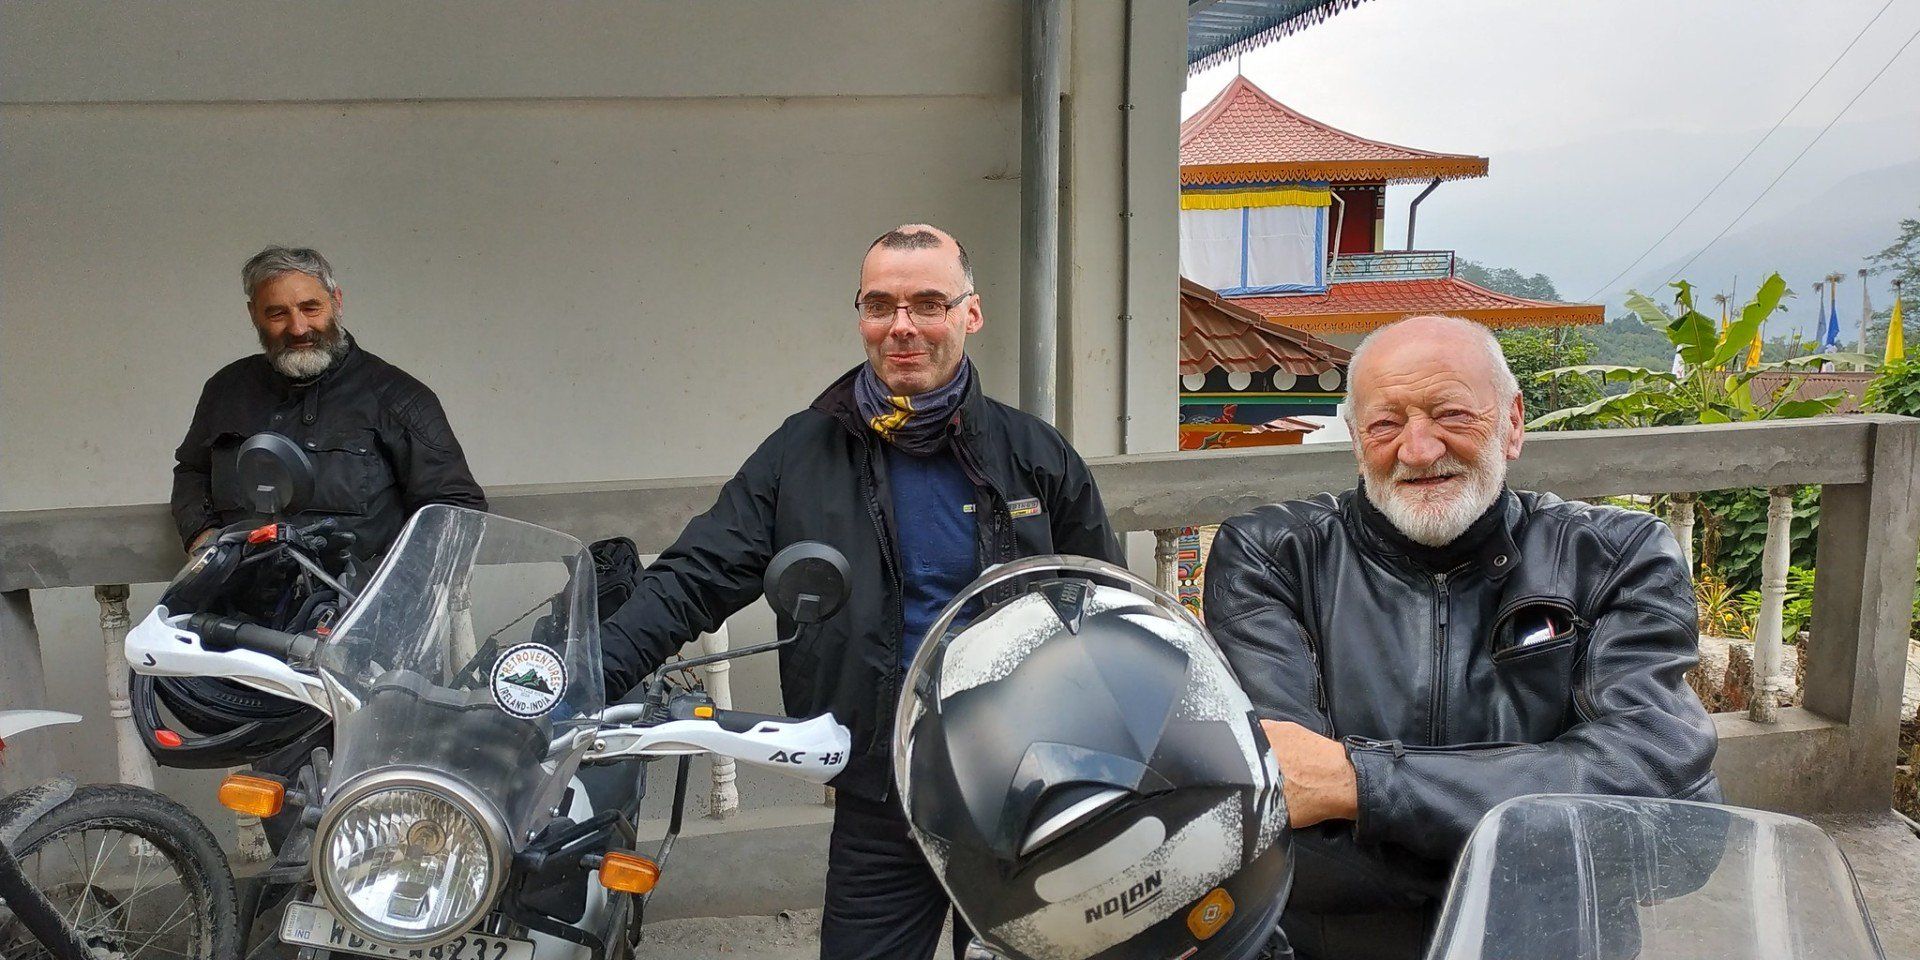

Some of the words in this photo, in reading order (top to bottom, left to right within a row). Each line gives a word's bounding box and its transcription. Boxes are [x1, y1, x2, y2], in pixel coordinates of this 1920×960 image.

[502, 651, 560, 687] RETROVENTURES
[500, 687, 551, 711] IRELAND-INDIA
[1084, 869, 1163, 924] NOLAN
